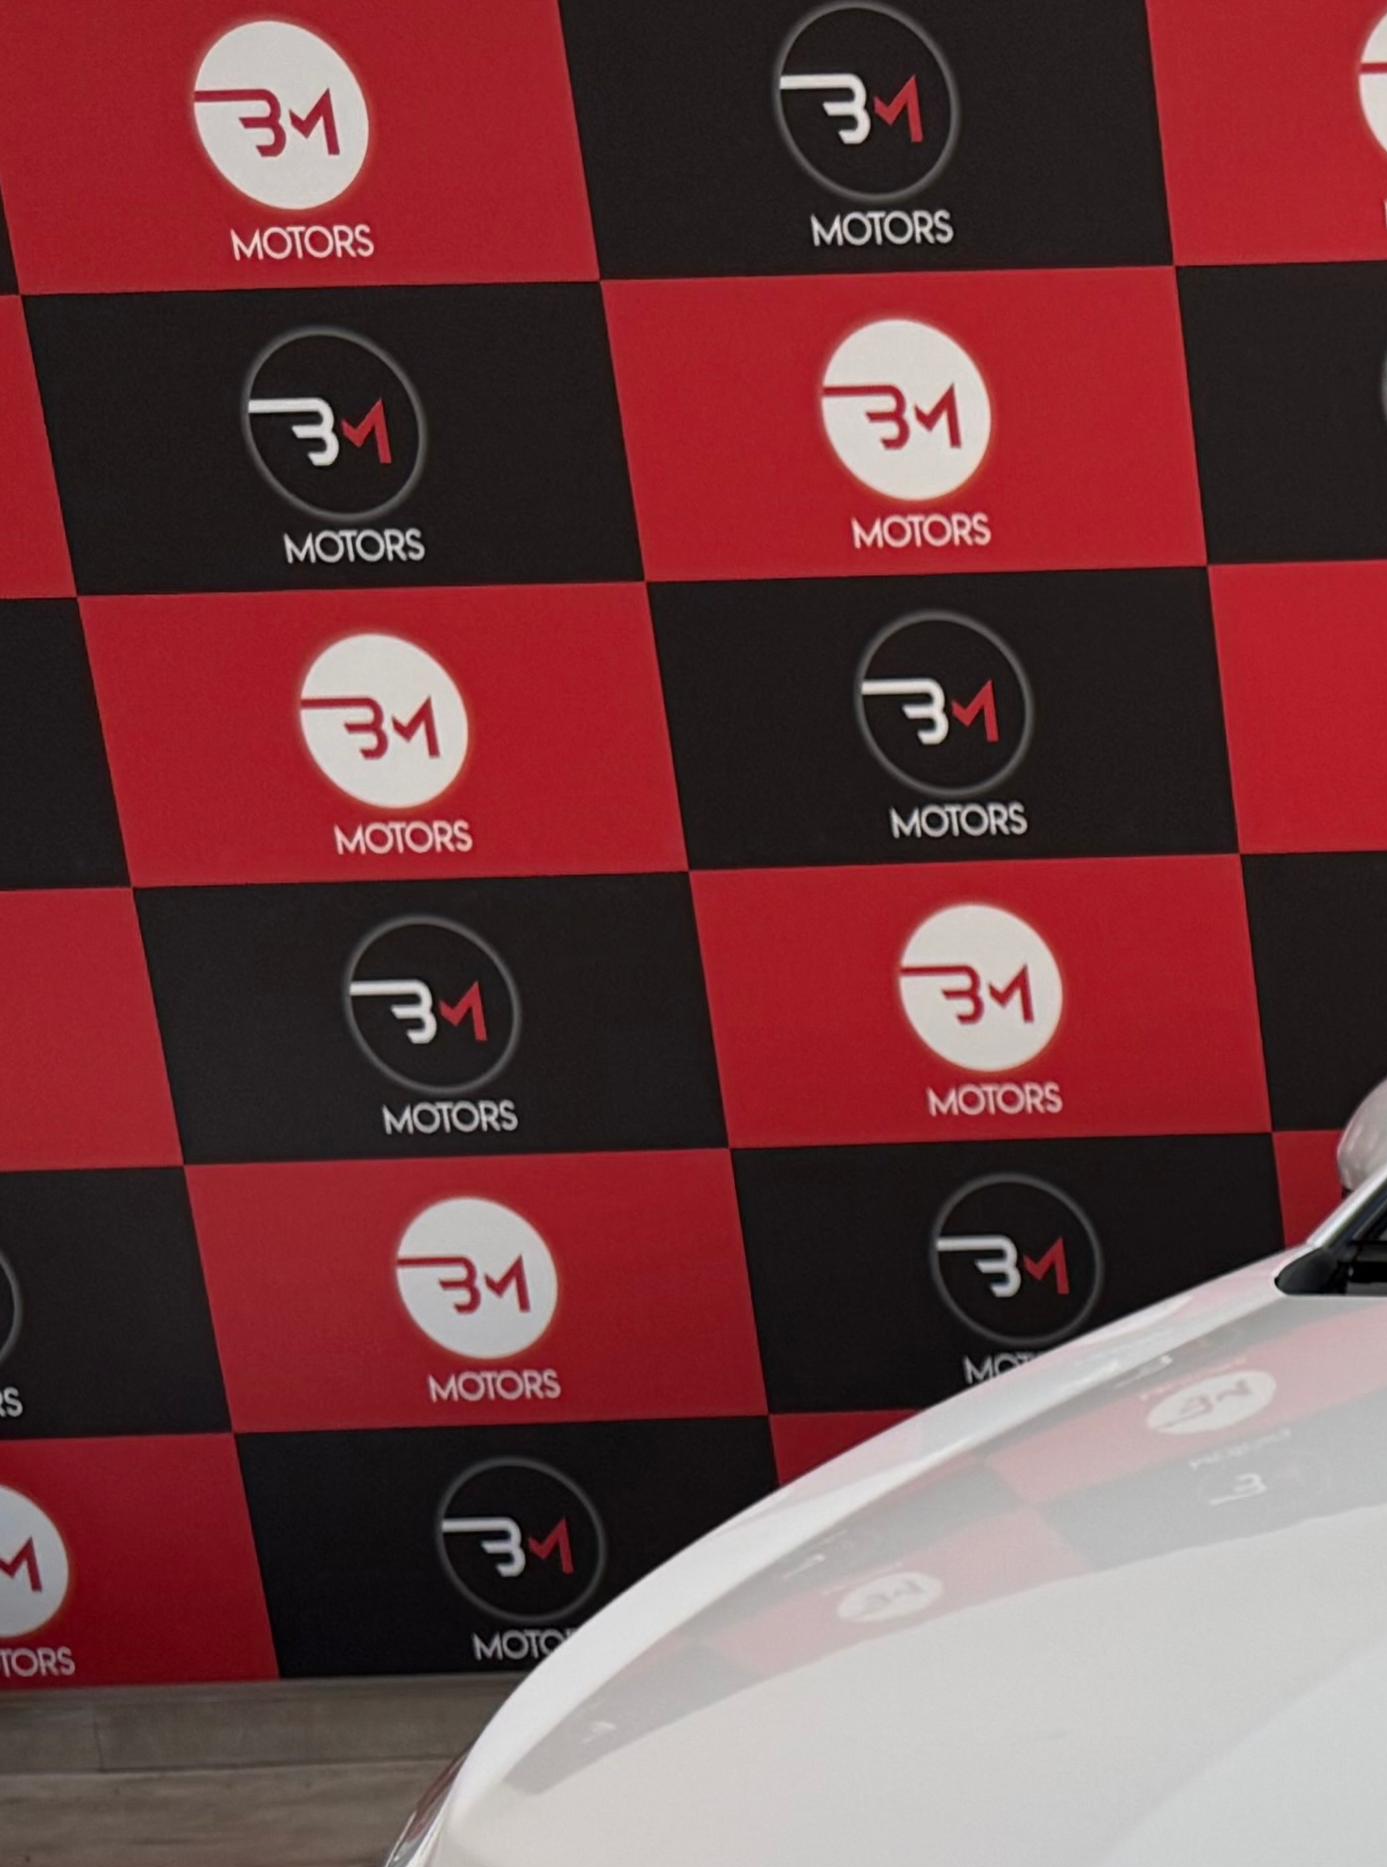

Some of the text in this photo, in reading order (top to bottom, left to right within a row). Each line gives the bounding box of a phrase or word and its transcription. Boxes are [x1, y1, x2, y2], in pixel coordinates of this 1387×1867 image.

[230, 224, 375, 262] MOTORS
[810, 210, 954, 249] MOTORS
[283, 528, 426, 565] MOTORS
[851, 513, 992, 550] MOTORS
[334, 820, 472, 856] MOTORS
[890, 802, 1028, 839] MOTORS
[383, 1100, 518, 1138] MOTORS
[927, 1083, 1062, 1118] MOTORS
[429, 1370, 561, 1403] MOTORS
[0, 1646, 75, 1678] TORS
[473, 1629, 575, 1661] MOTO
